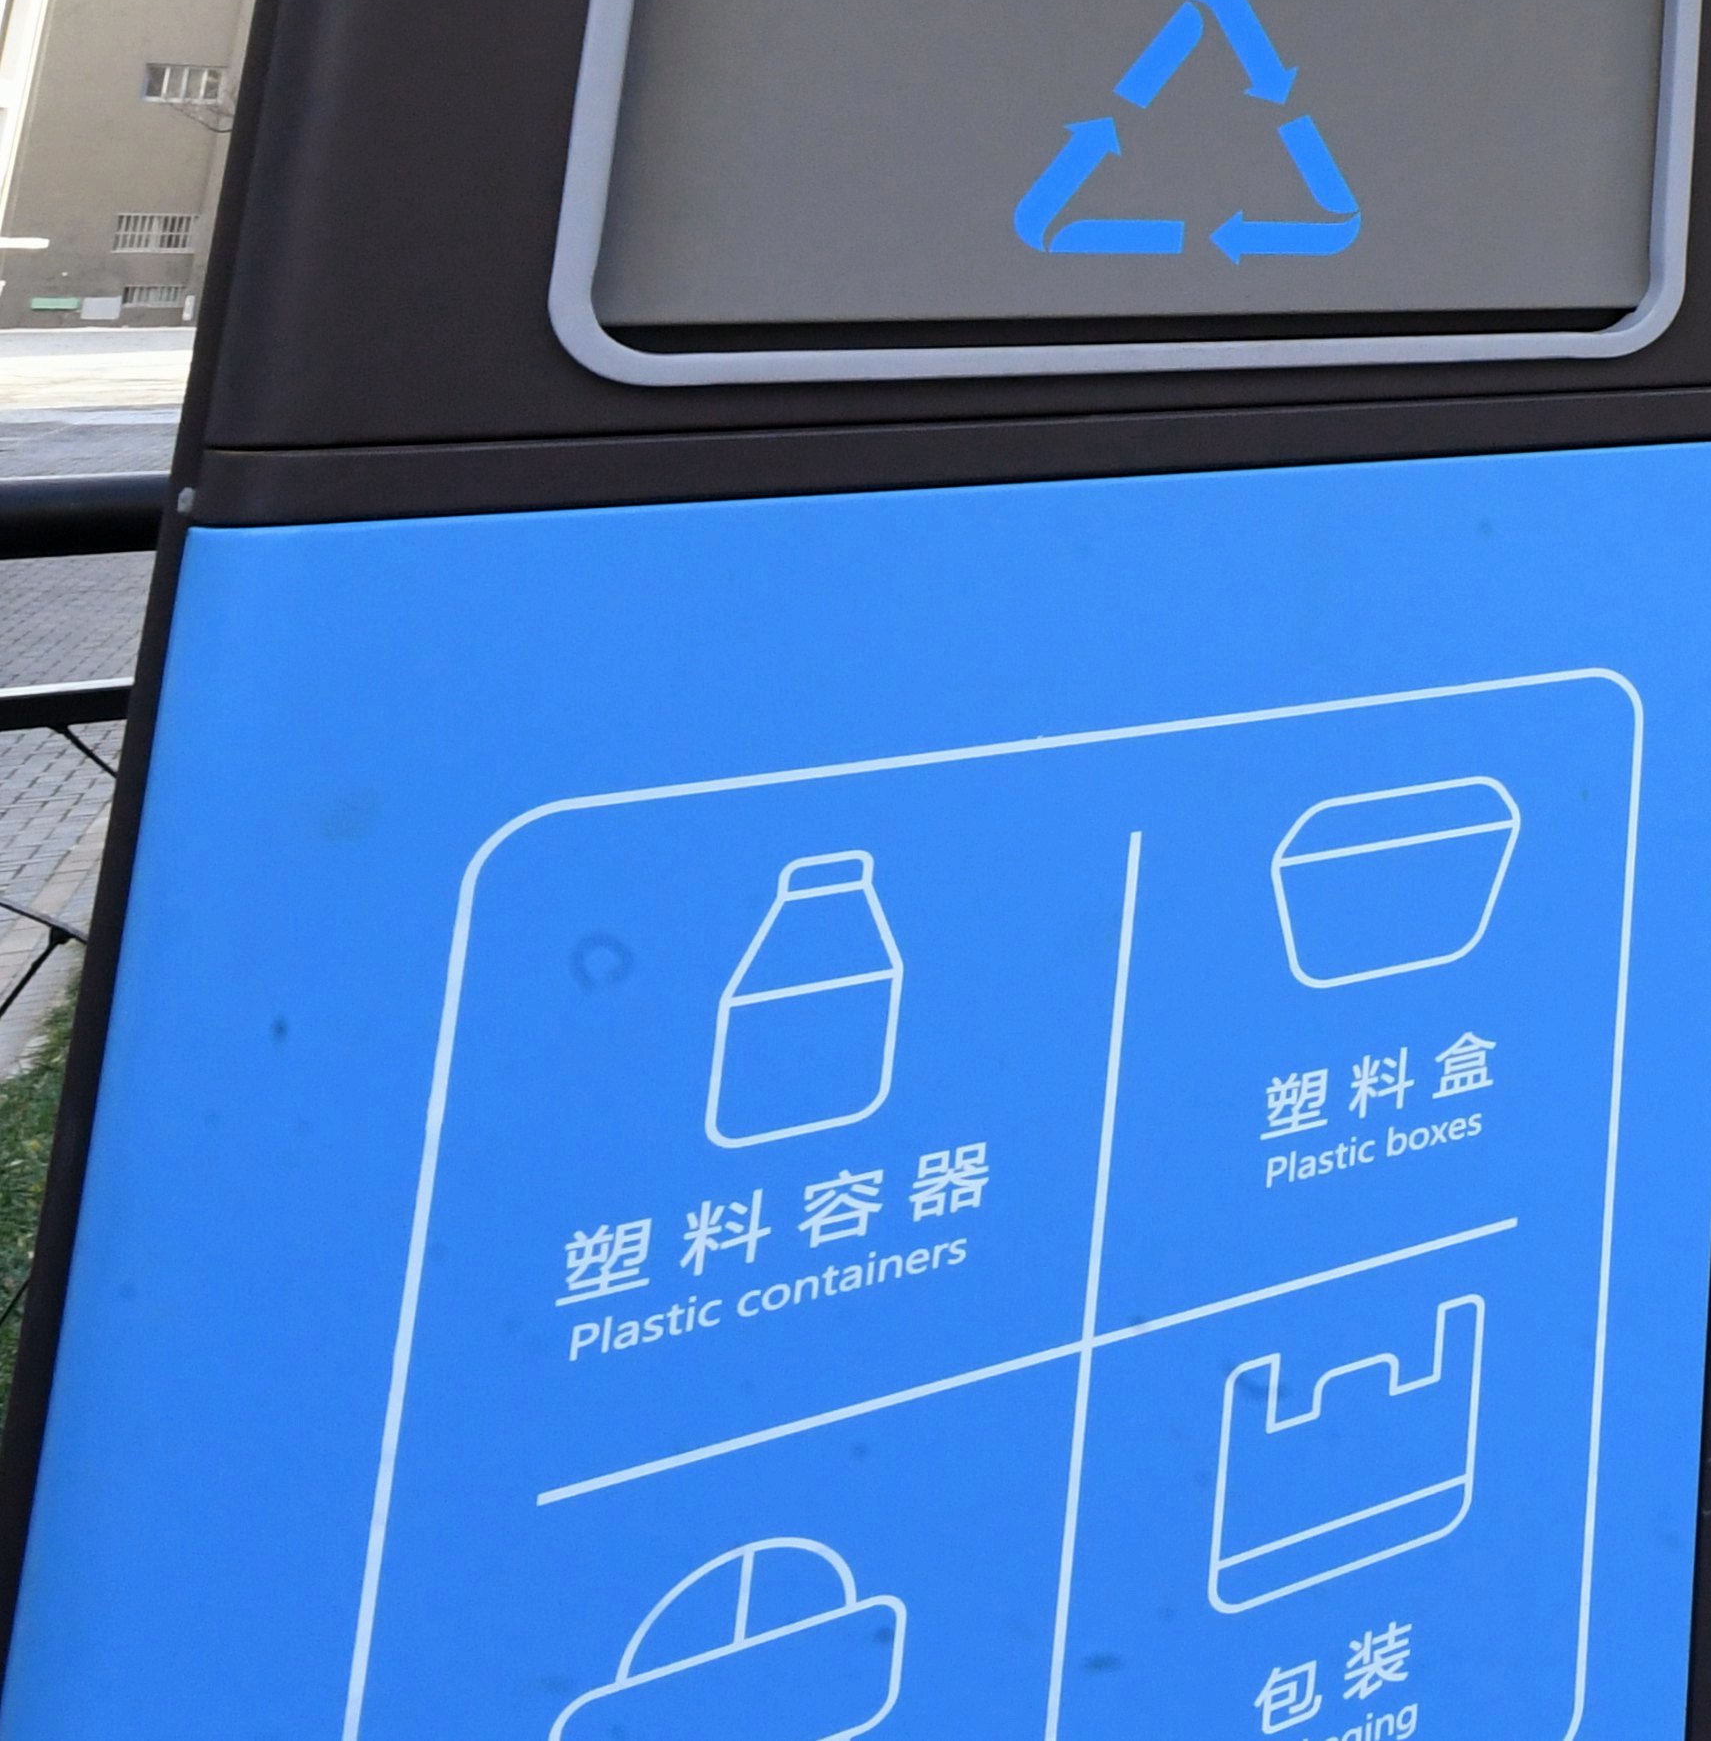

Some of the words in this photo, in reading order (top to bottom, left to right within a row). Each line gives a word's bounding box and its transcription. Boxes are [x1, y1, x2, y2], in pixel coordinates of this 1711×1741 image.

[1259, 1031, 1499, 1142] 塑料盒
[1264, 1139, 1376, 1190] Plastic
[1386, 1110, 1485, 1161] boxes
[555, 1140, 993, 1307] 塑料容器
[567, 1289, 722, 1363] Plastic
[735, 1234, 969, 1322] containers
[1253, 1620, 1413, 1735] 包装
